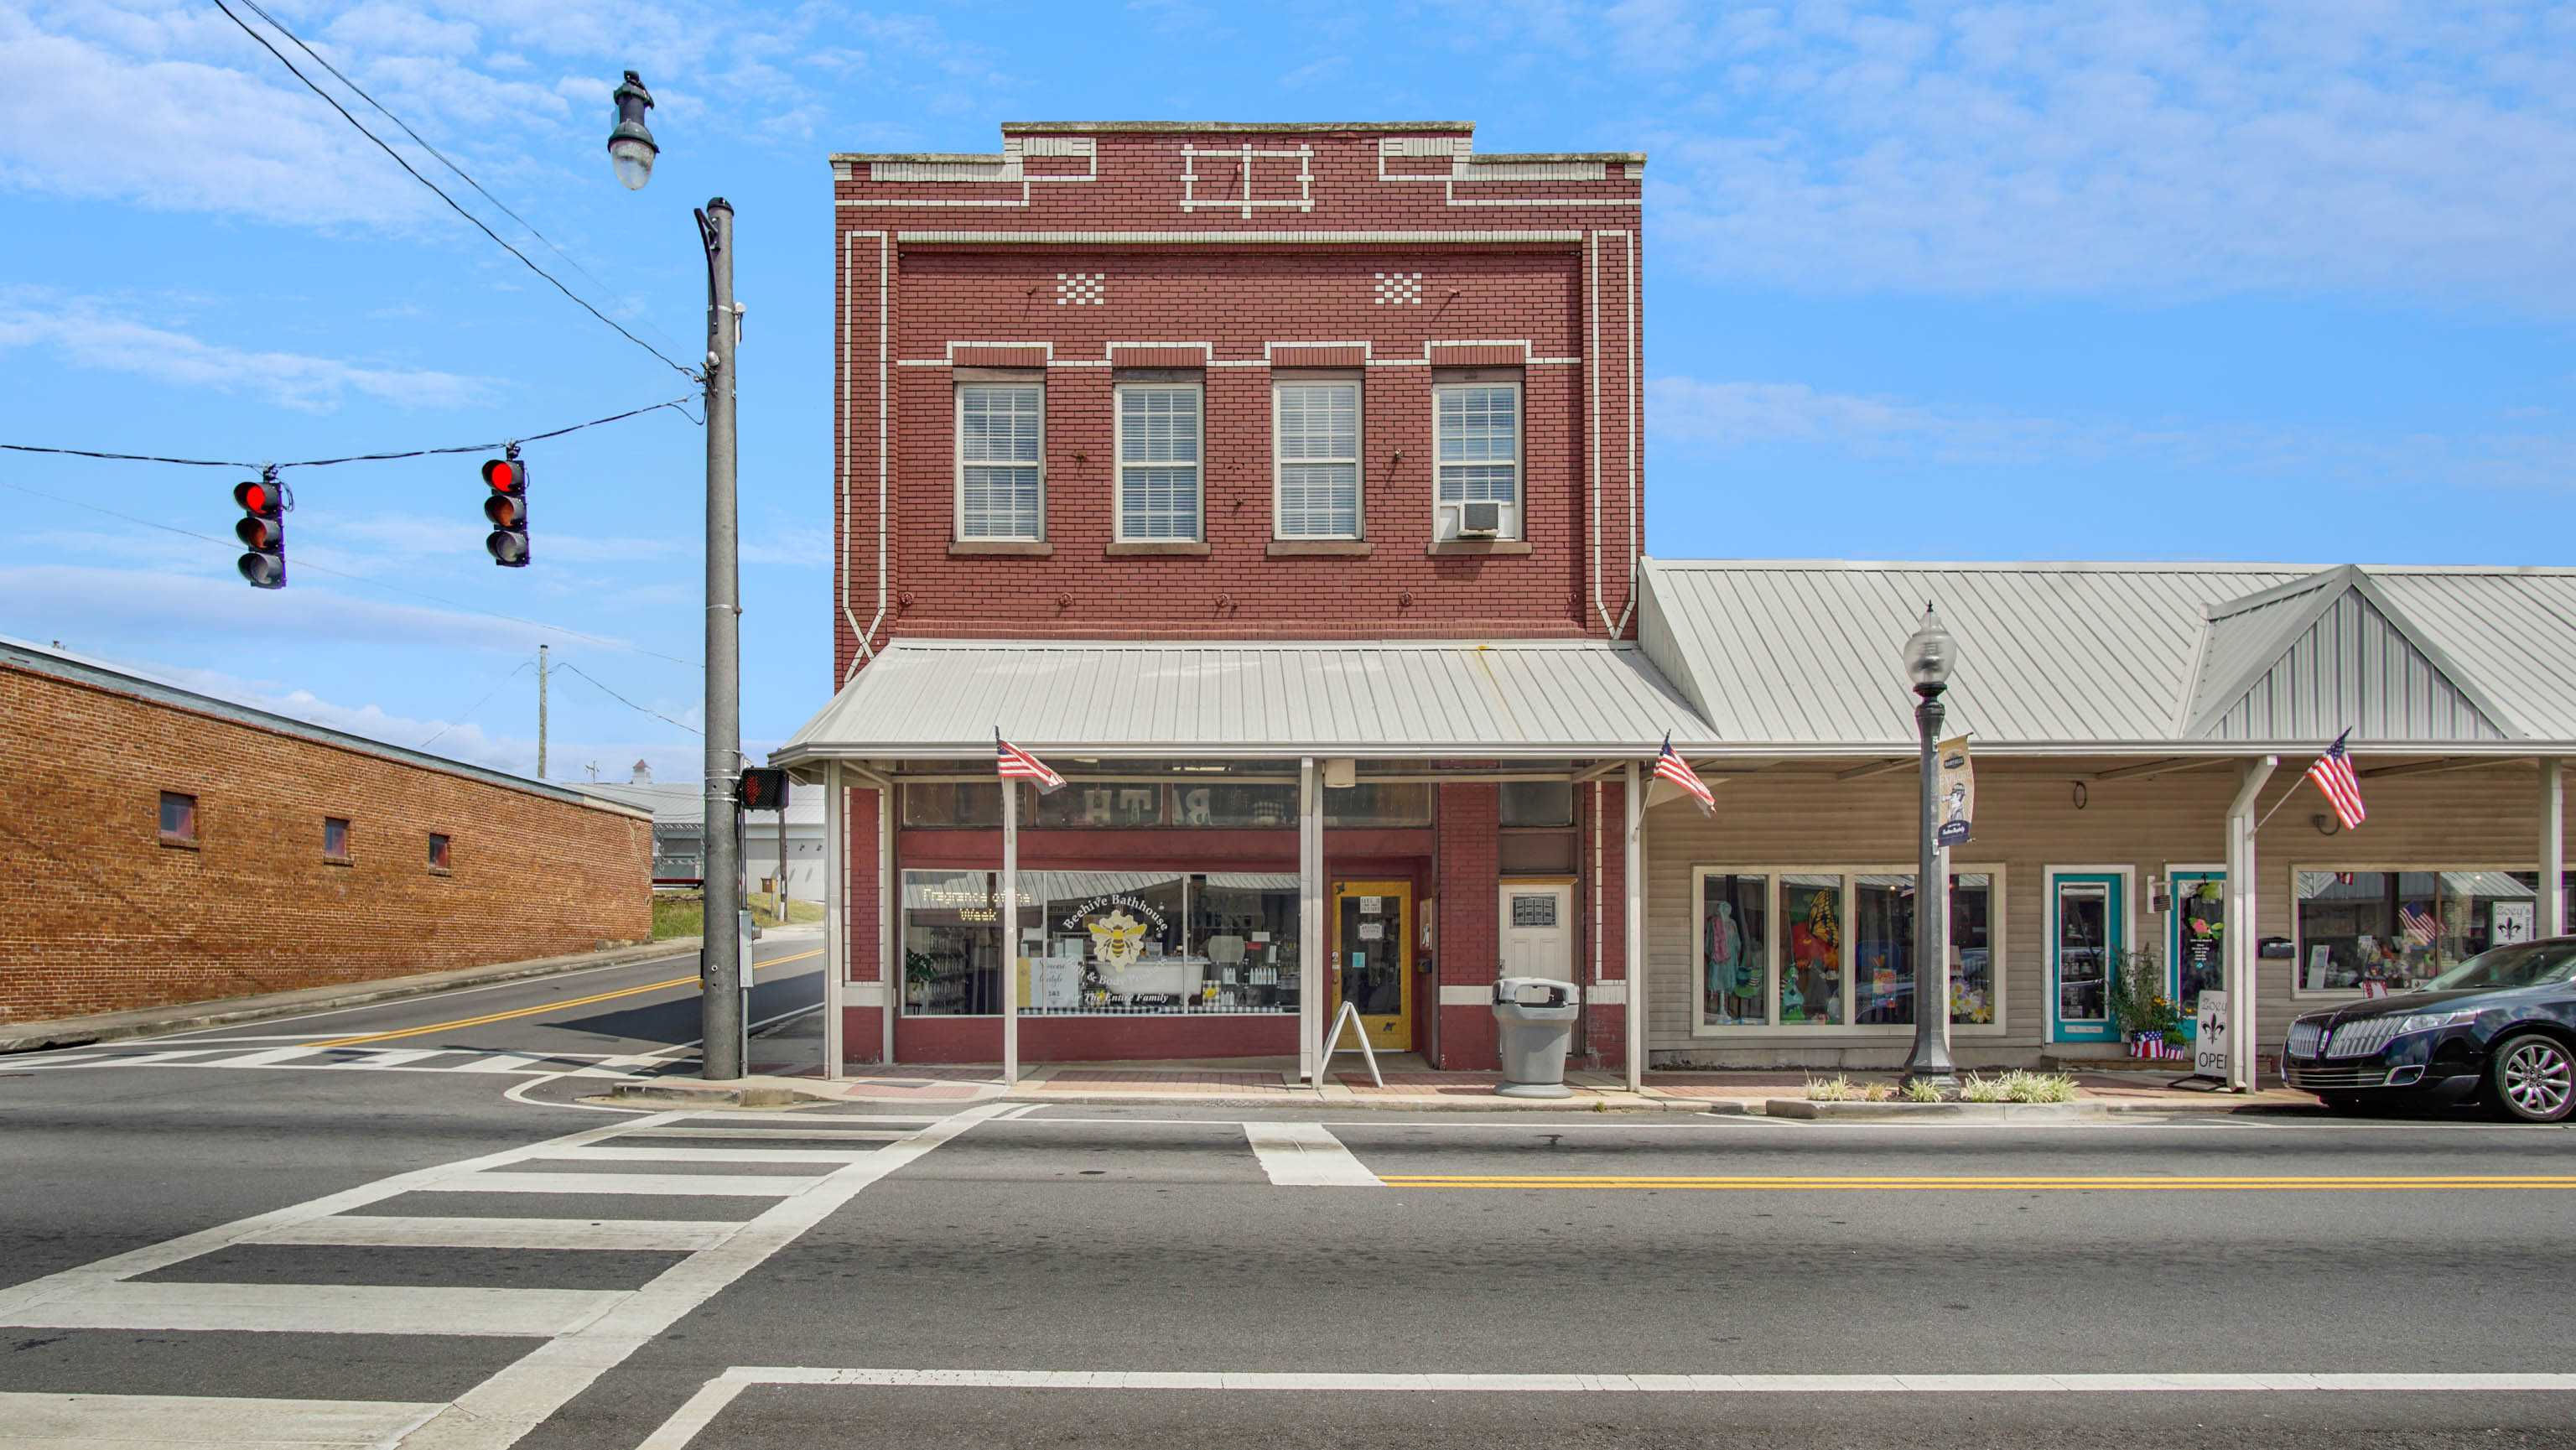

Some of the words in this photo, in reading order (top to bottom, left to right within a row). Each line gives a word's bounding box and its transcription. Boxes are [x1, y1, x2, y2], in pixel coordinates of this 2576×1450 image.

[959, 907, 996, 922] Week
[1062, 897, 1108, 930] Beehive
[1112, 894, 1168, 932] Bathhouse
[1084, 993, 1102, 1001] The
[1104, 992, 1134, 1002] Entire
[1136, 992, 1170, 1004] Family
